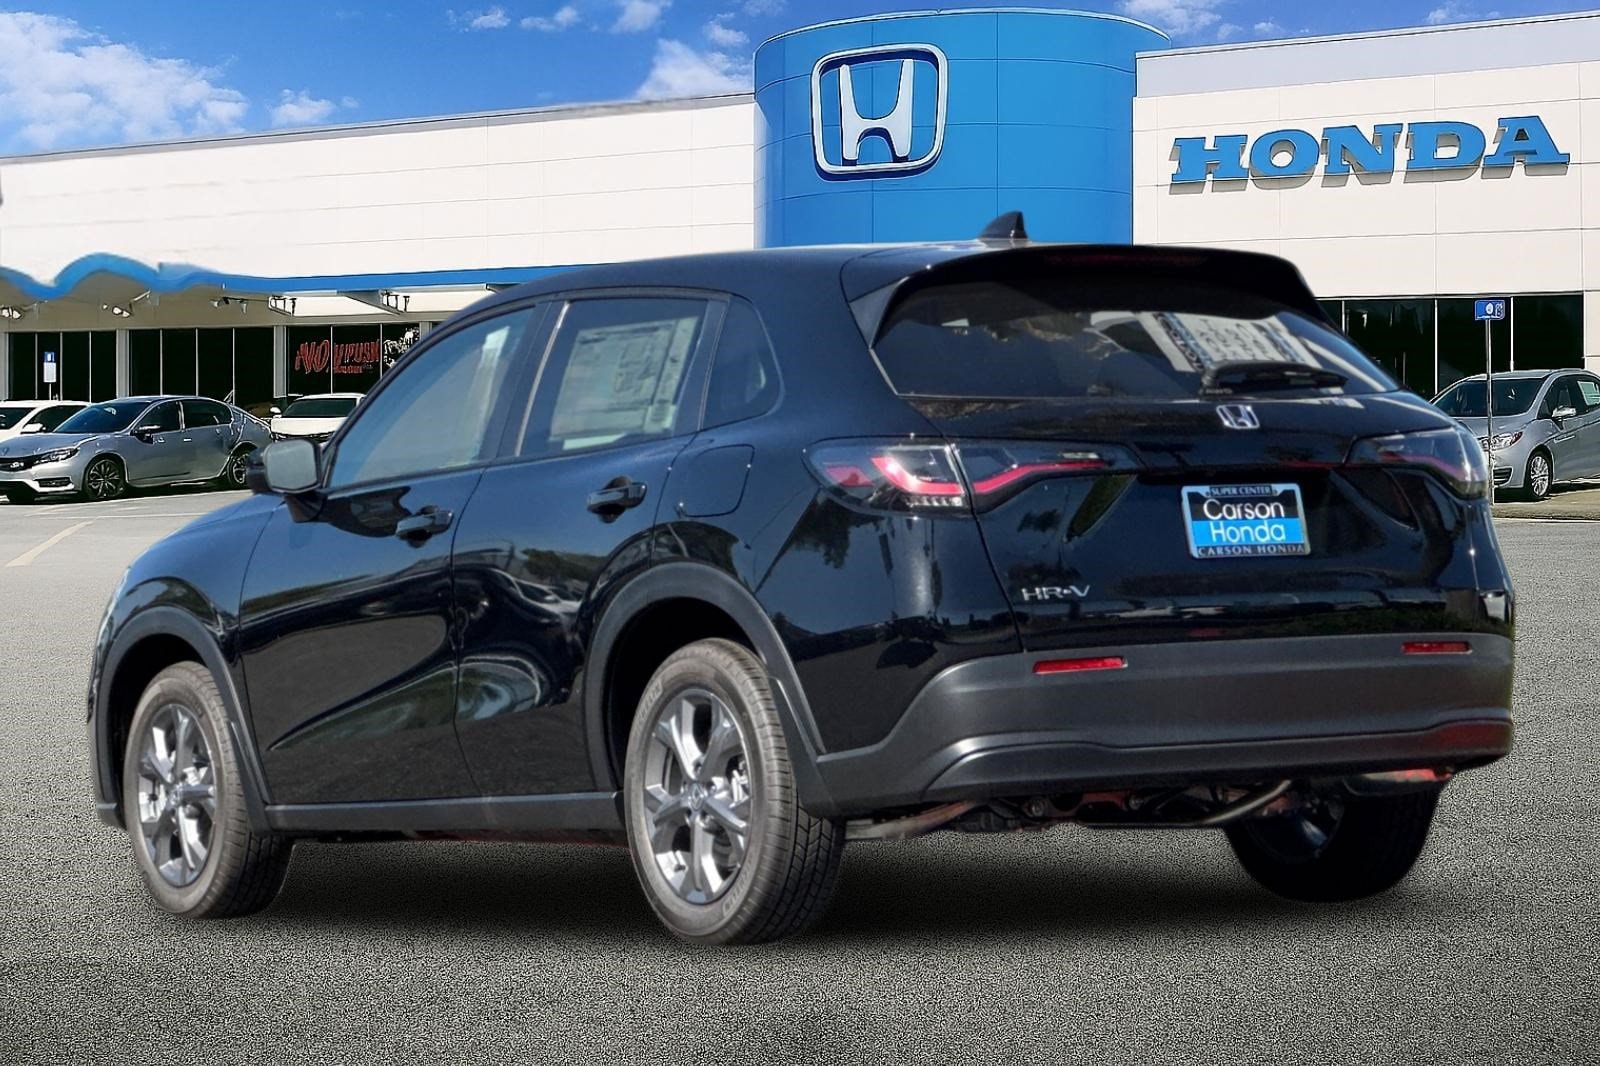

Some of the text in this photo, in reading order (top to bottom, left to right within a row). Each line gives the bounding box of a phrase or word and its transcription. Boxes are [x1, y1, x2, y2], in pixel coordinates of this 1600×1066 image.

[1170, 115, 1571, 188] HONDA
[1211, 485, 1272, 496] SUPER CENTER
[1203, 498, 1286, 520] Carson
[1209, 519, 1286, 543] Honda
[1198, 544, 1306, 556] CARSON HONDA
